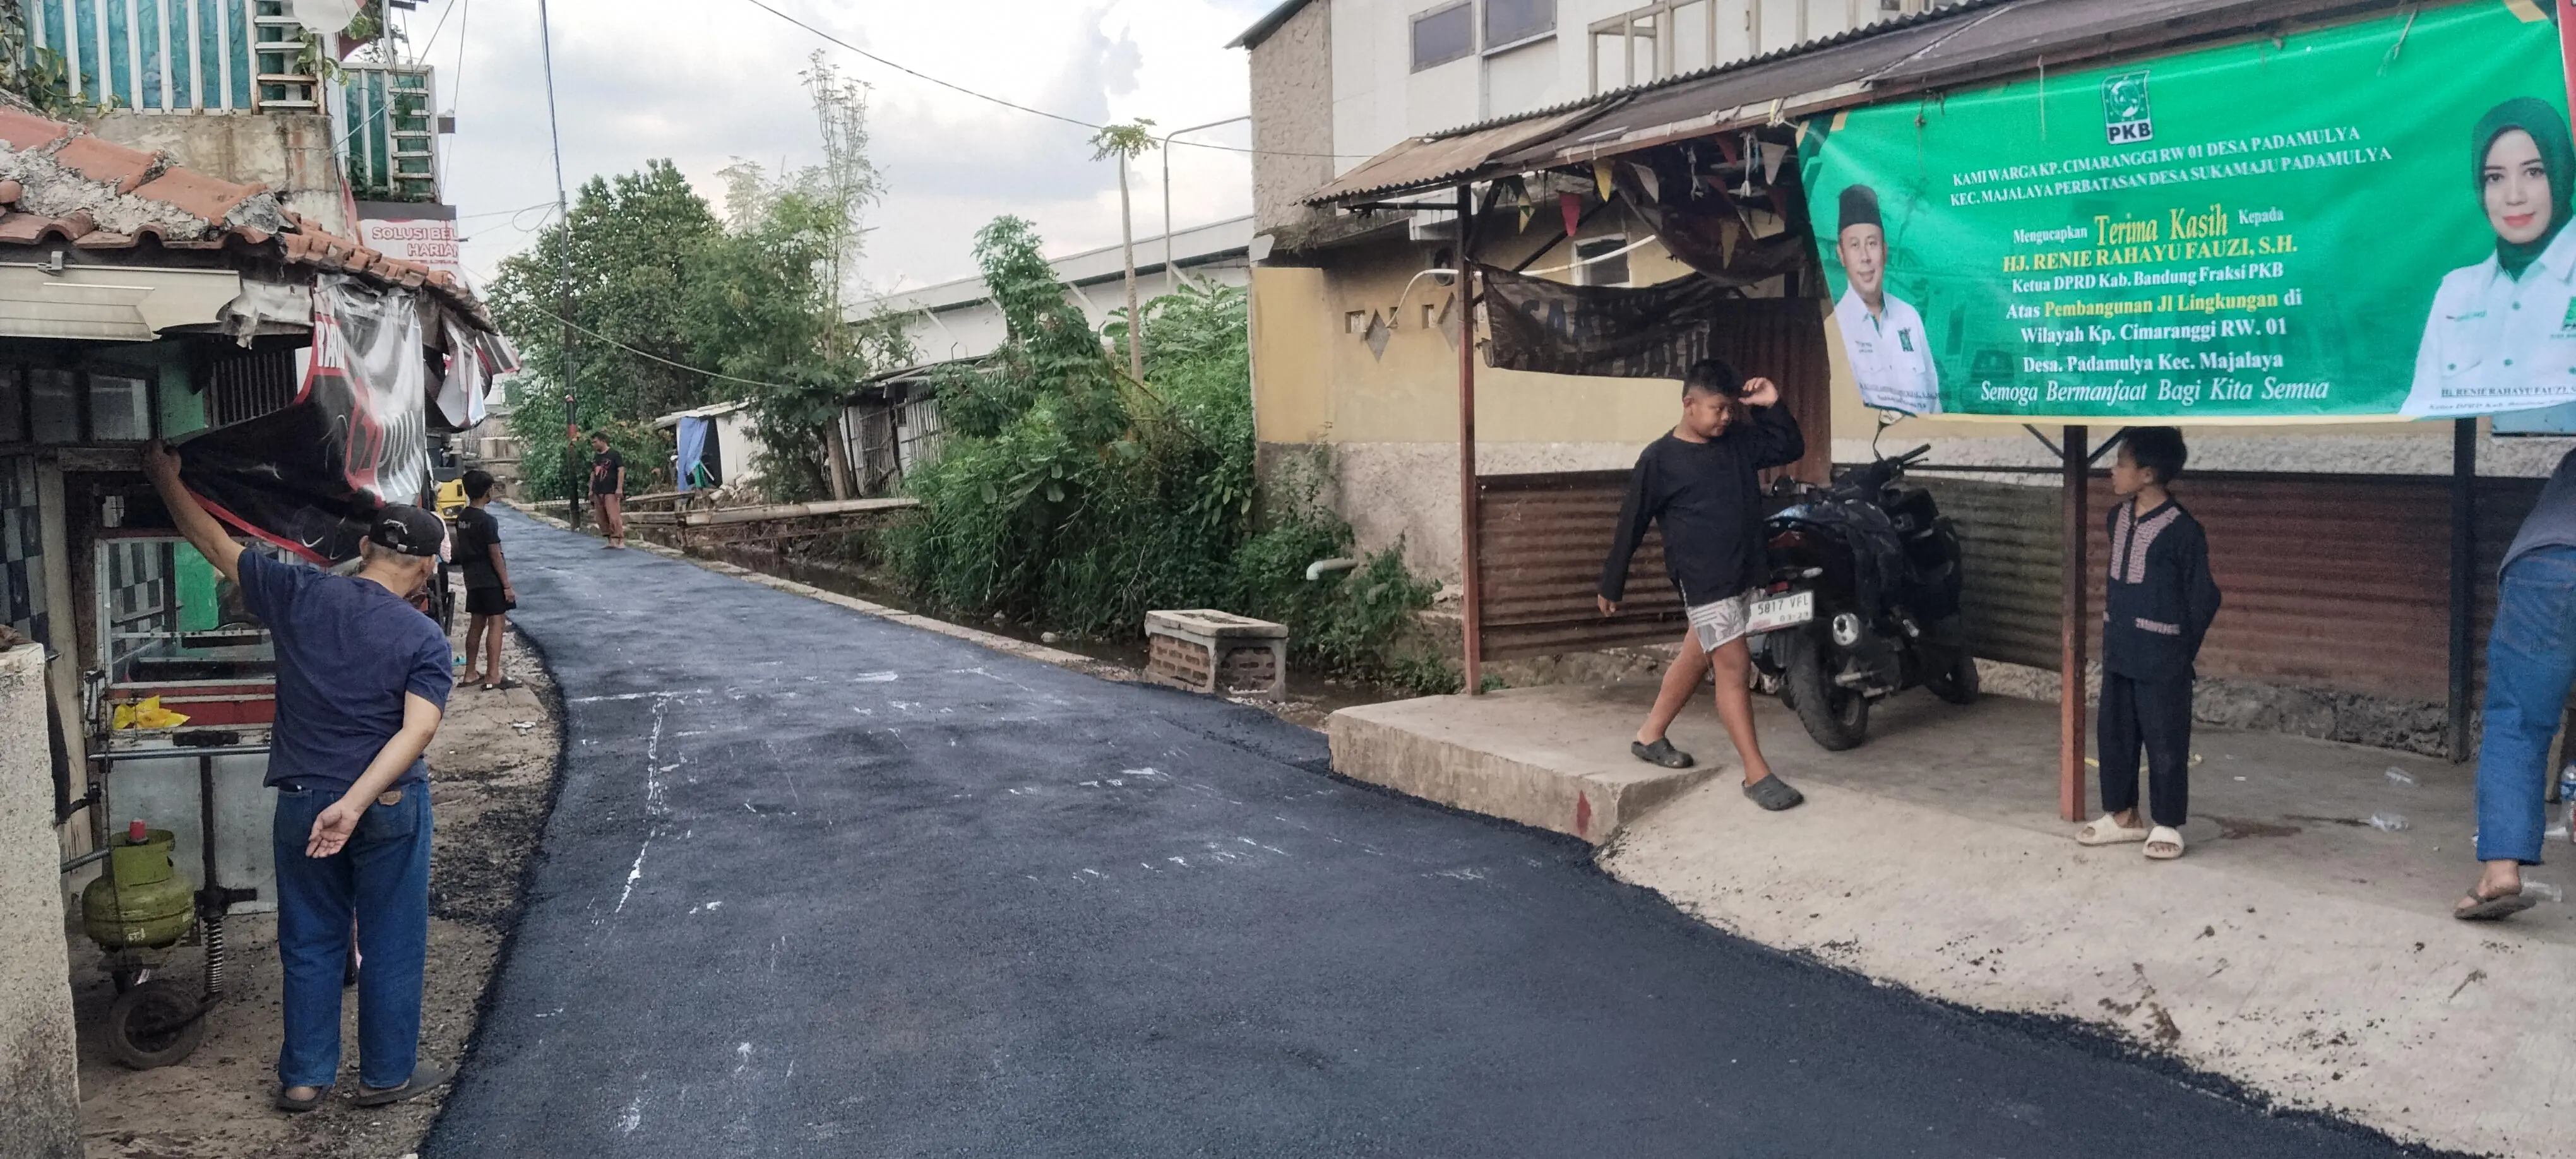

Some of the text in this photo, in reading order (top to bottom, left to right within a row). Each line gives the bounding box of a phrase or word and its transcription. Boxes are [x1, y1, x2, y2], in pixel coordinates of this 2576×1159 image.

[2109, 122, 2150, 141] PKB
[1953, 126, 2361, 186] KAMI WARGA KP. CIMARANGGI RW 01 DESA PADAMULYA
[1950, 146, 2392, 206] KEC. MAJALAYA PERBATASAN DESA SUKAMAJU PADAMULYA
[372, 227, 428, 240] SOLUSI
[2013, 203, 2284, 246] Mengucapkan Terima Kasih Kepada
[2003, 234, 2298, 272] HJ. RENIE RAHAYU FAUZI, S.H.
[2012, 261, 2284, 293] Ketua DPRD Kab. Bandung Fraksi PKB
[2006, 288, 2303, 319] Atas Pembangunan Jl Lingkungan di
[2021, 317, 2287, 347] Wilayah Kp. Cimaranggi RW. 01
[2022, 350, 2284, 375] Desa. Padamulya Kec. Majalaya
[1981, 380, 2038, 407] Semoga
[2046, 378, 2147, 407] Bermanfaat
[2157, 378, 2202, 407] Bagi
[2210, 377, 2253, 401] Kita
[2261, 376, 2330, 400] Semua
[1789, 595, 1808, 608] VFL
